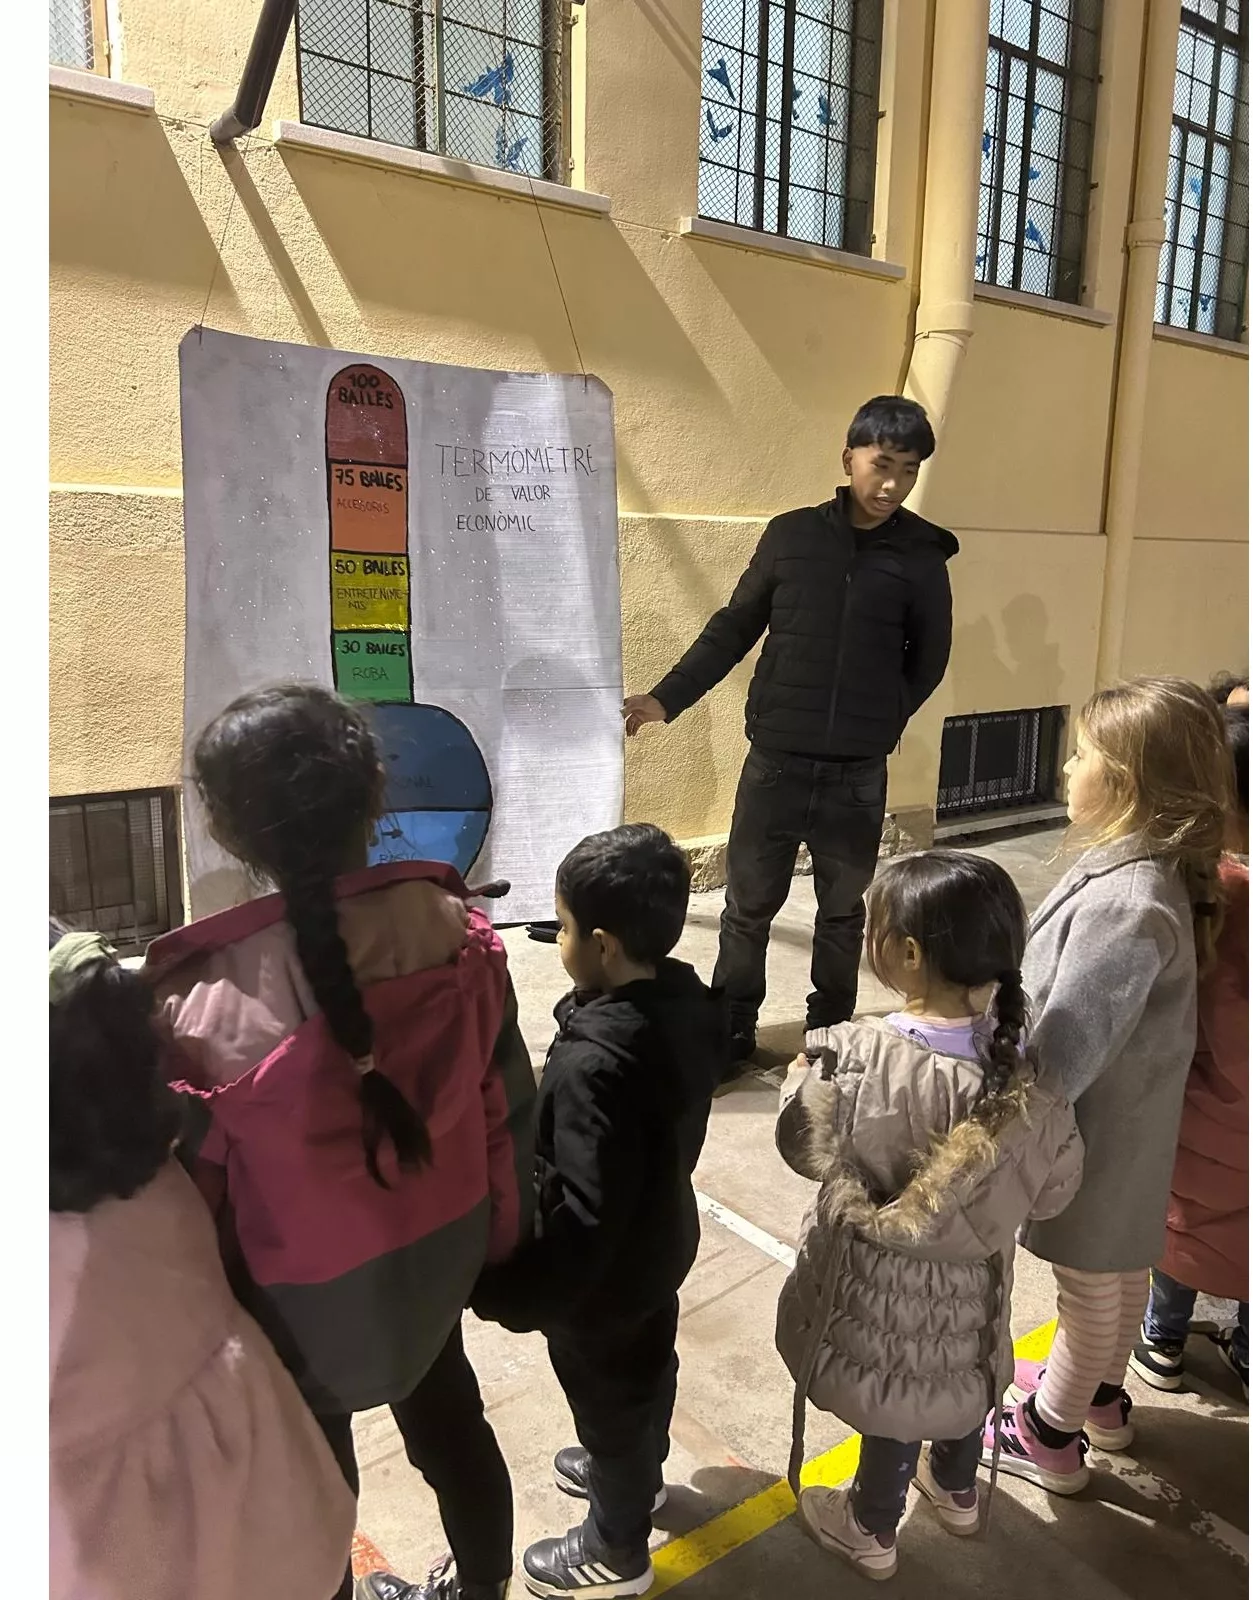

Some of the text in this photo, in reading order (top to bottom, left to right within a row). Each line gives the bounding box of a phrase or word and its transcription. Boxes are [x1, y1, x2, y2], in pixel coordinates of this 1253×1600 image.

[348, 373, 381, 389] 100
[335, 468, 355, 486] 75
[475, 484, 551, 502] DE VALOR
[456, 510, 536, 533] ECONÒMIC
[335, 559, 356, 575] 50
[341, 639, 406, 657] 30 BAILES
[352, 666, 390, 681] ROBA
